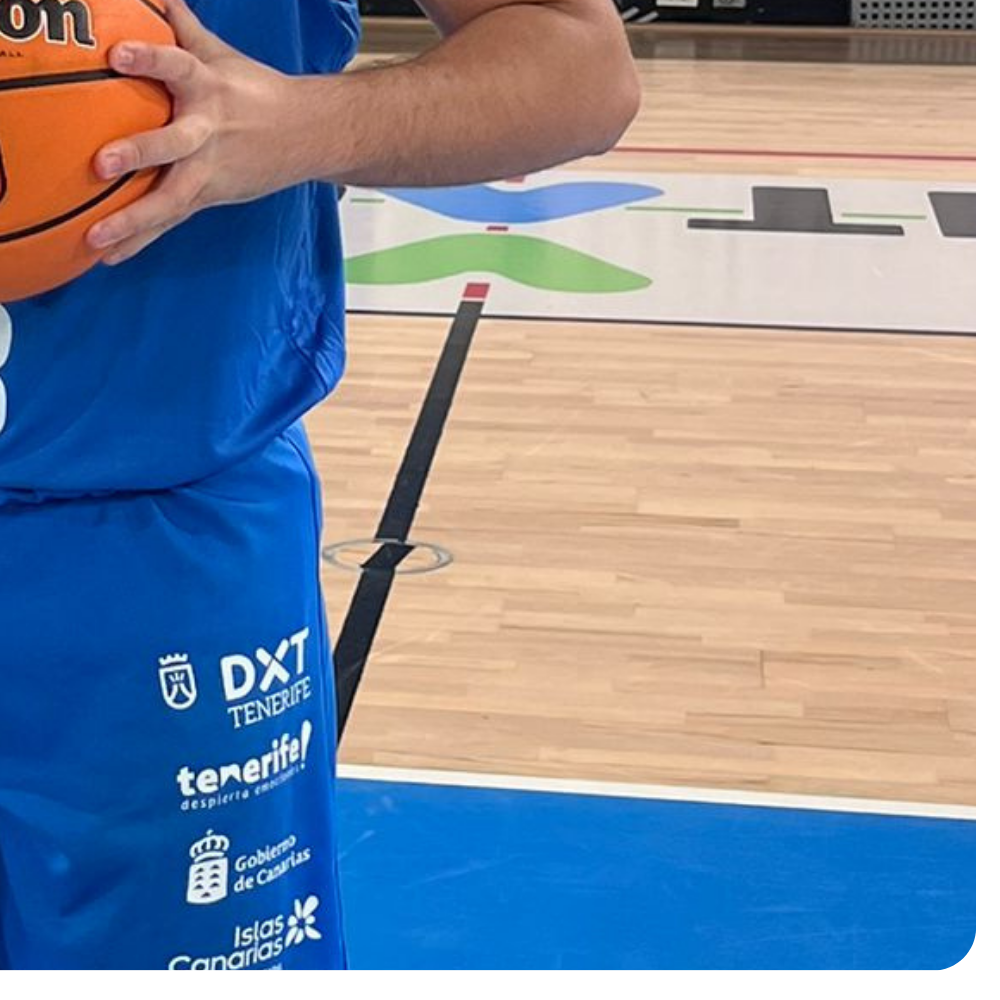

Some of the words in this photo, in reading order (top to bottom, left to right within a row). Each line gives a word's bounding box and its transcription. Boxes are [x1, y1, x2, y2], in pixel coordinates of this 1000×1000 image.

[220, 626, 310, 701] DXT
[227, 676, 312, 729] TENERIFE
[180, 791, 250, 811] despierta
[233, 875, 254, 893] de
[256, 848, 312, 886] Canarias
[234, 835, 297, 872] Gobierno
[233, 914, 285, 949] Islas
[168, 937, 284, 971] Canarias
